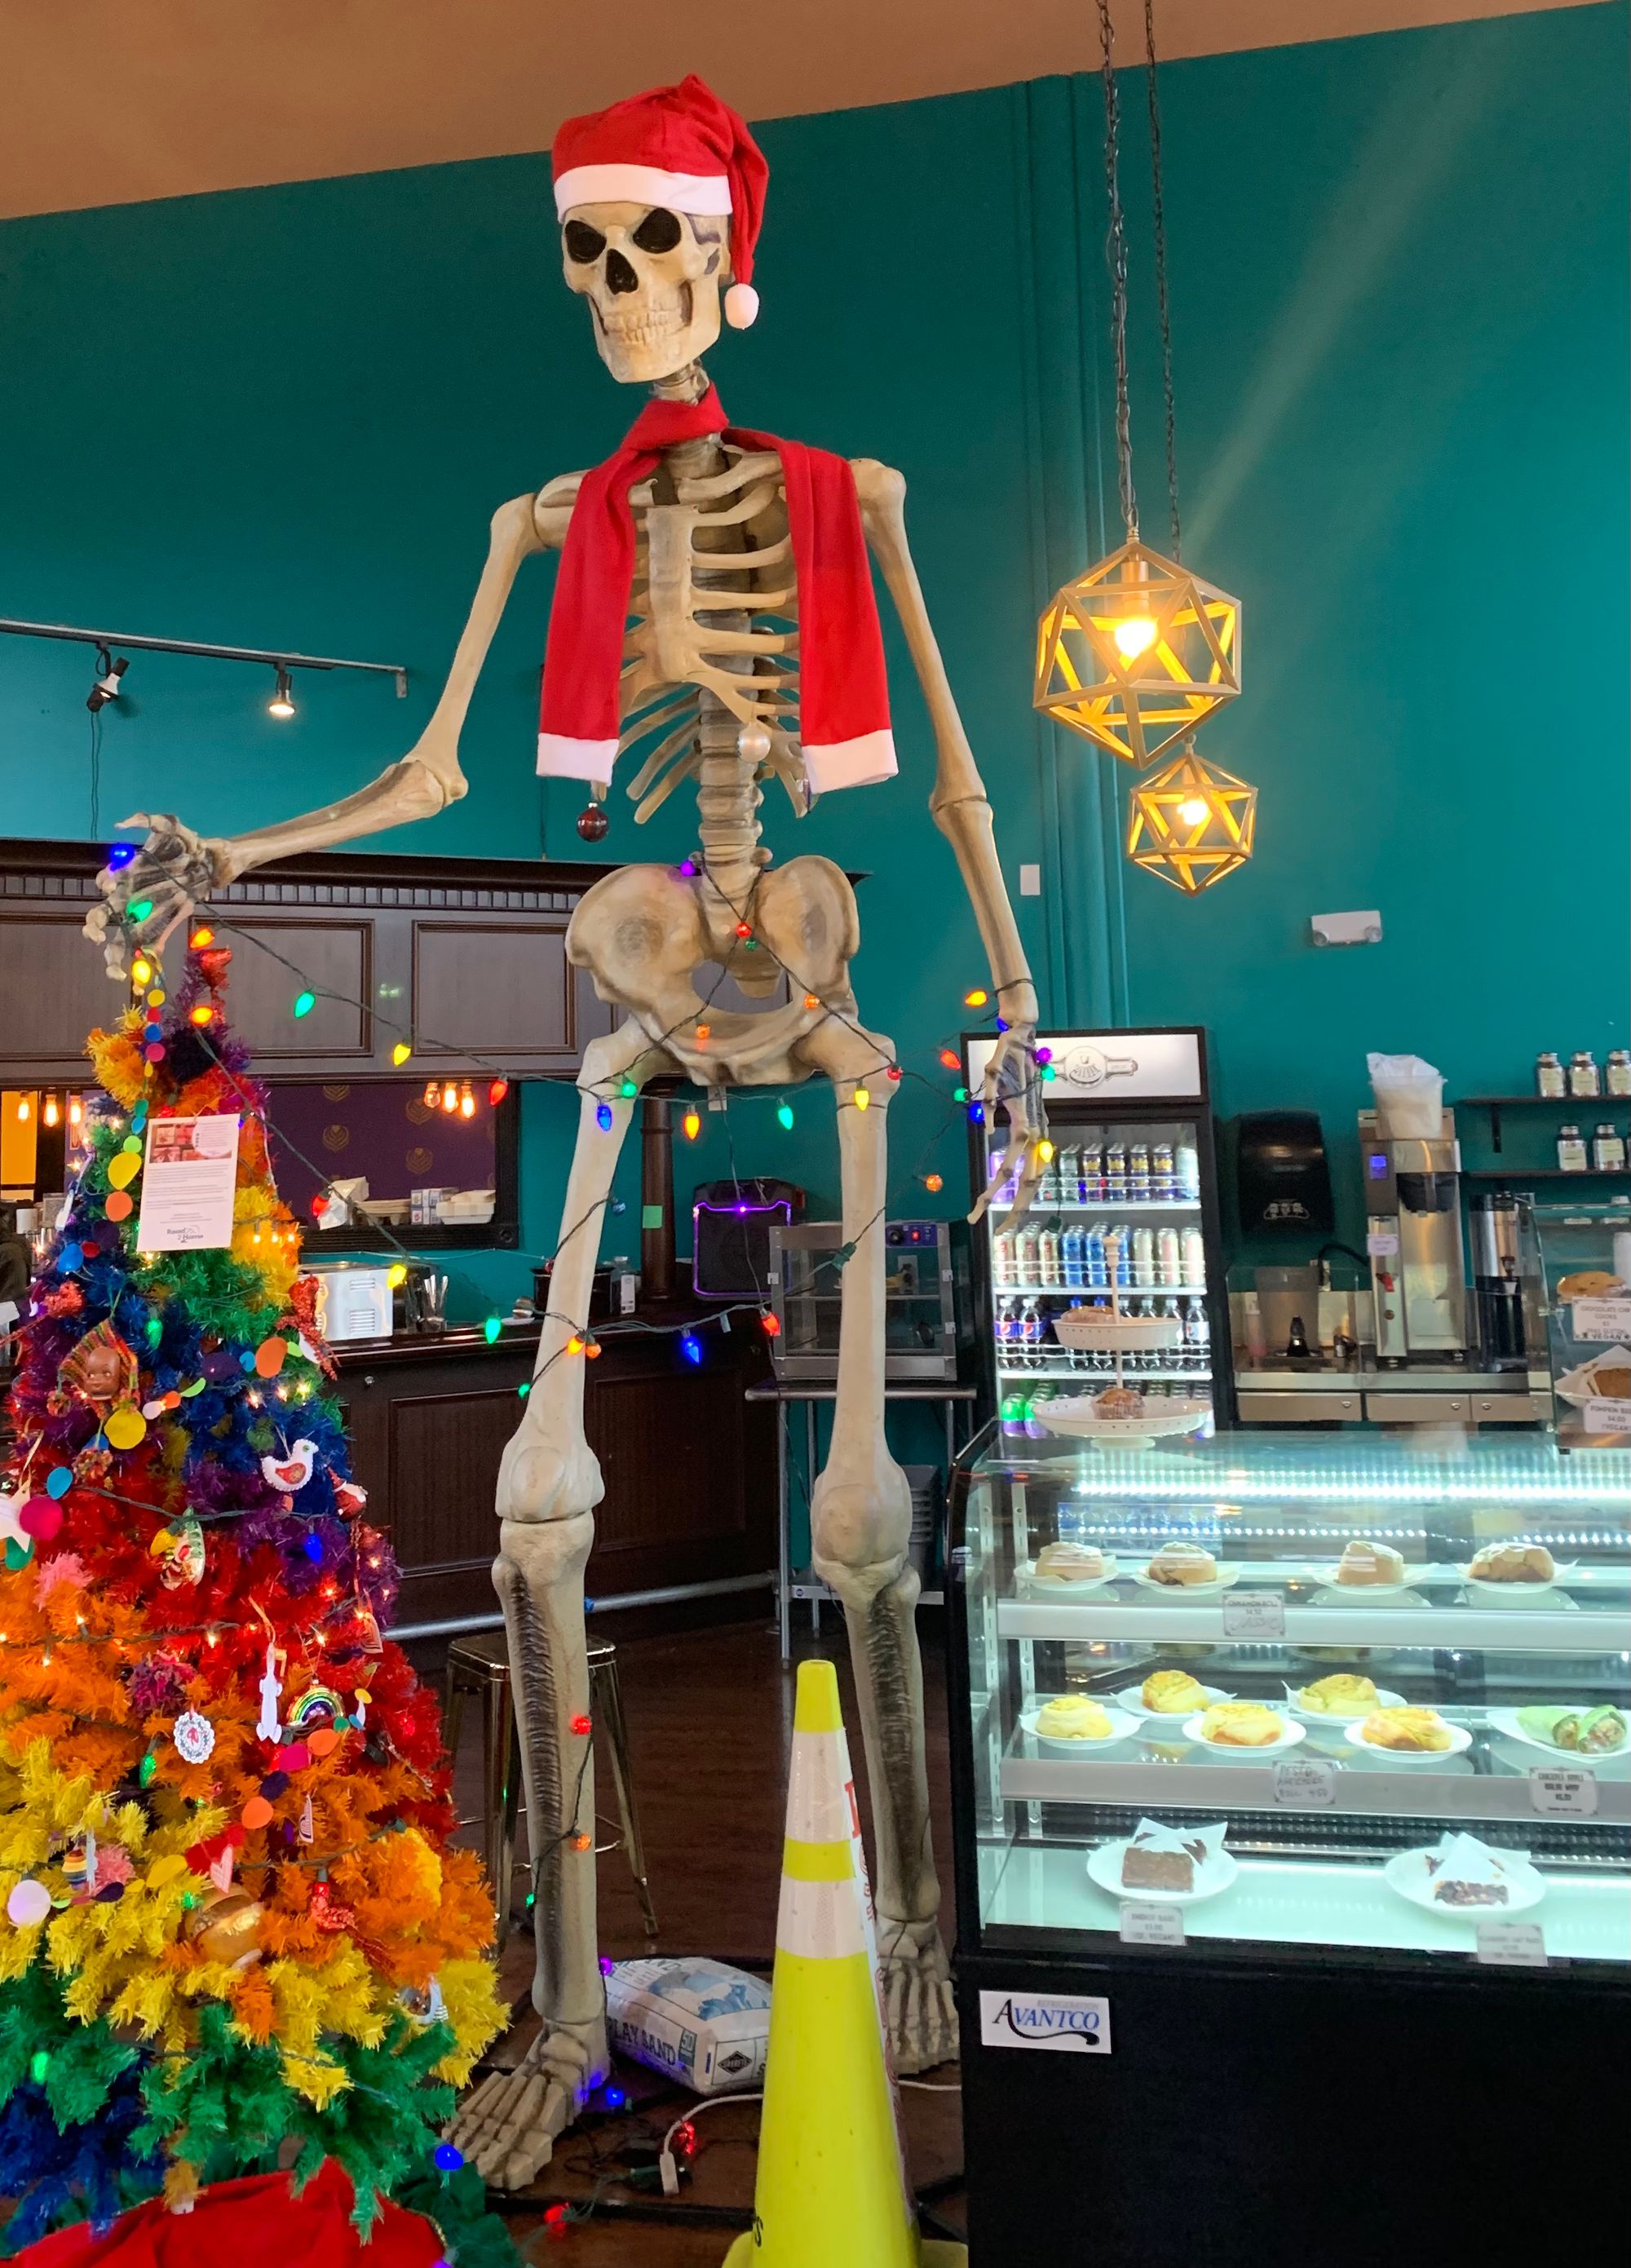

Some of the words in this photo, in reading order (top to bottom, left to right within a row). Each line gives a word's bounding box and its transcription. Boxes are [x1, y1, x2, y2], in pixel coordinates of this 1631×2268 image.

[1591, 1332, 1621, 1341] VEGAN
[992, 1998, 1100, 2036] AVANTCO
[642, 2029, 676, 2066] SAND
